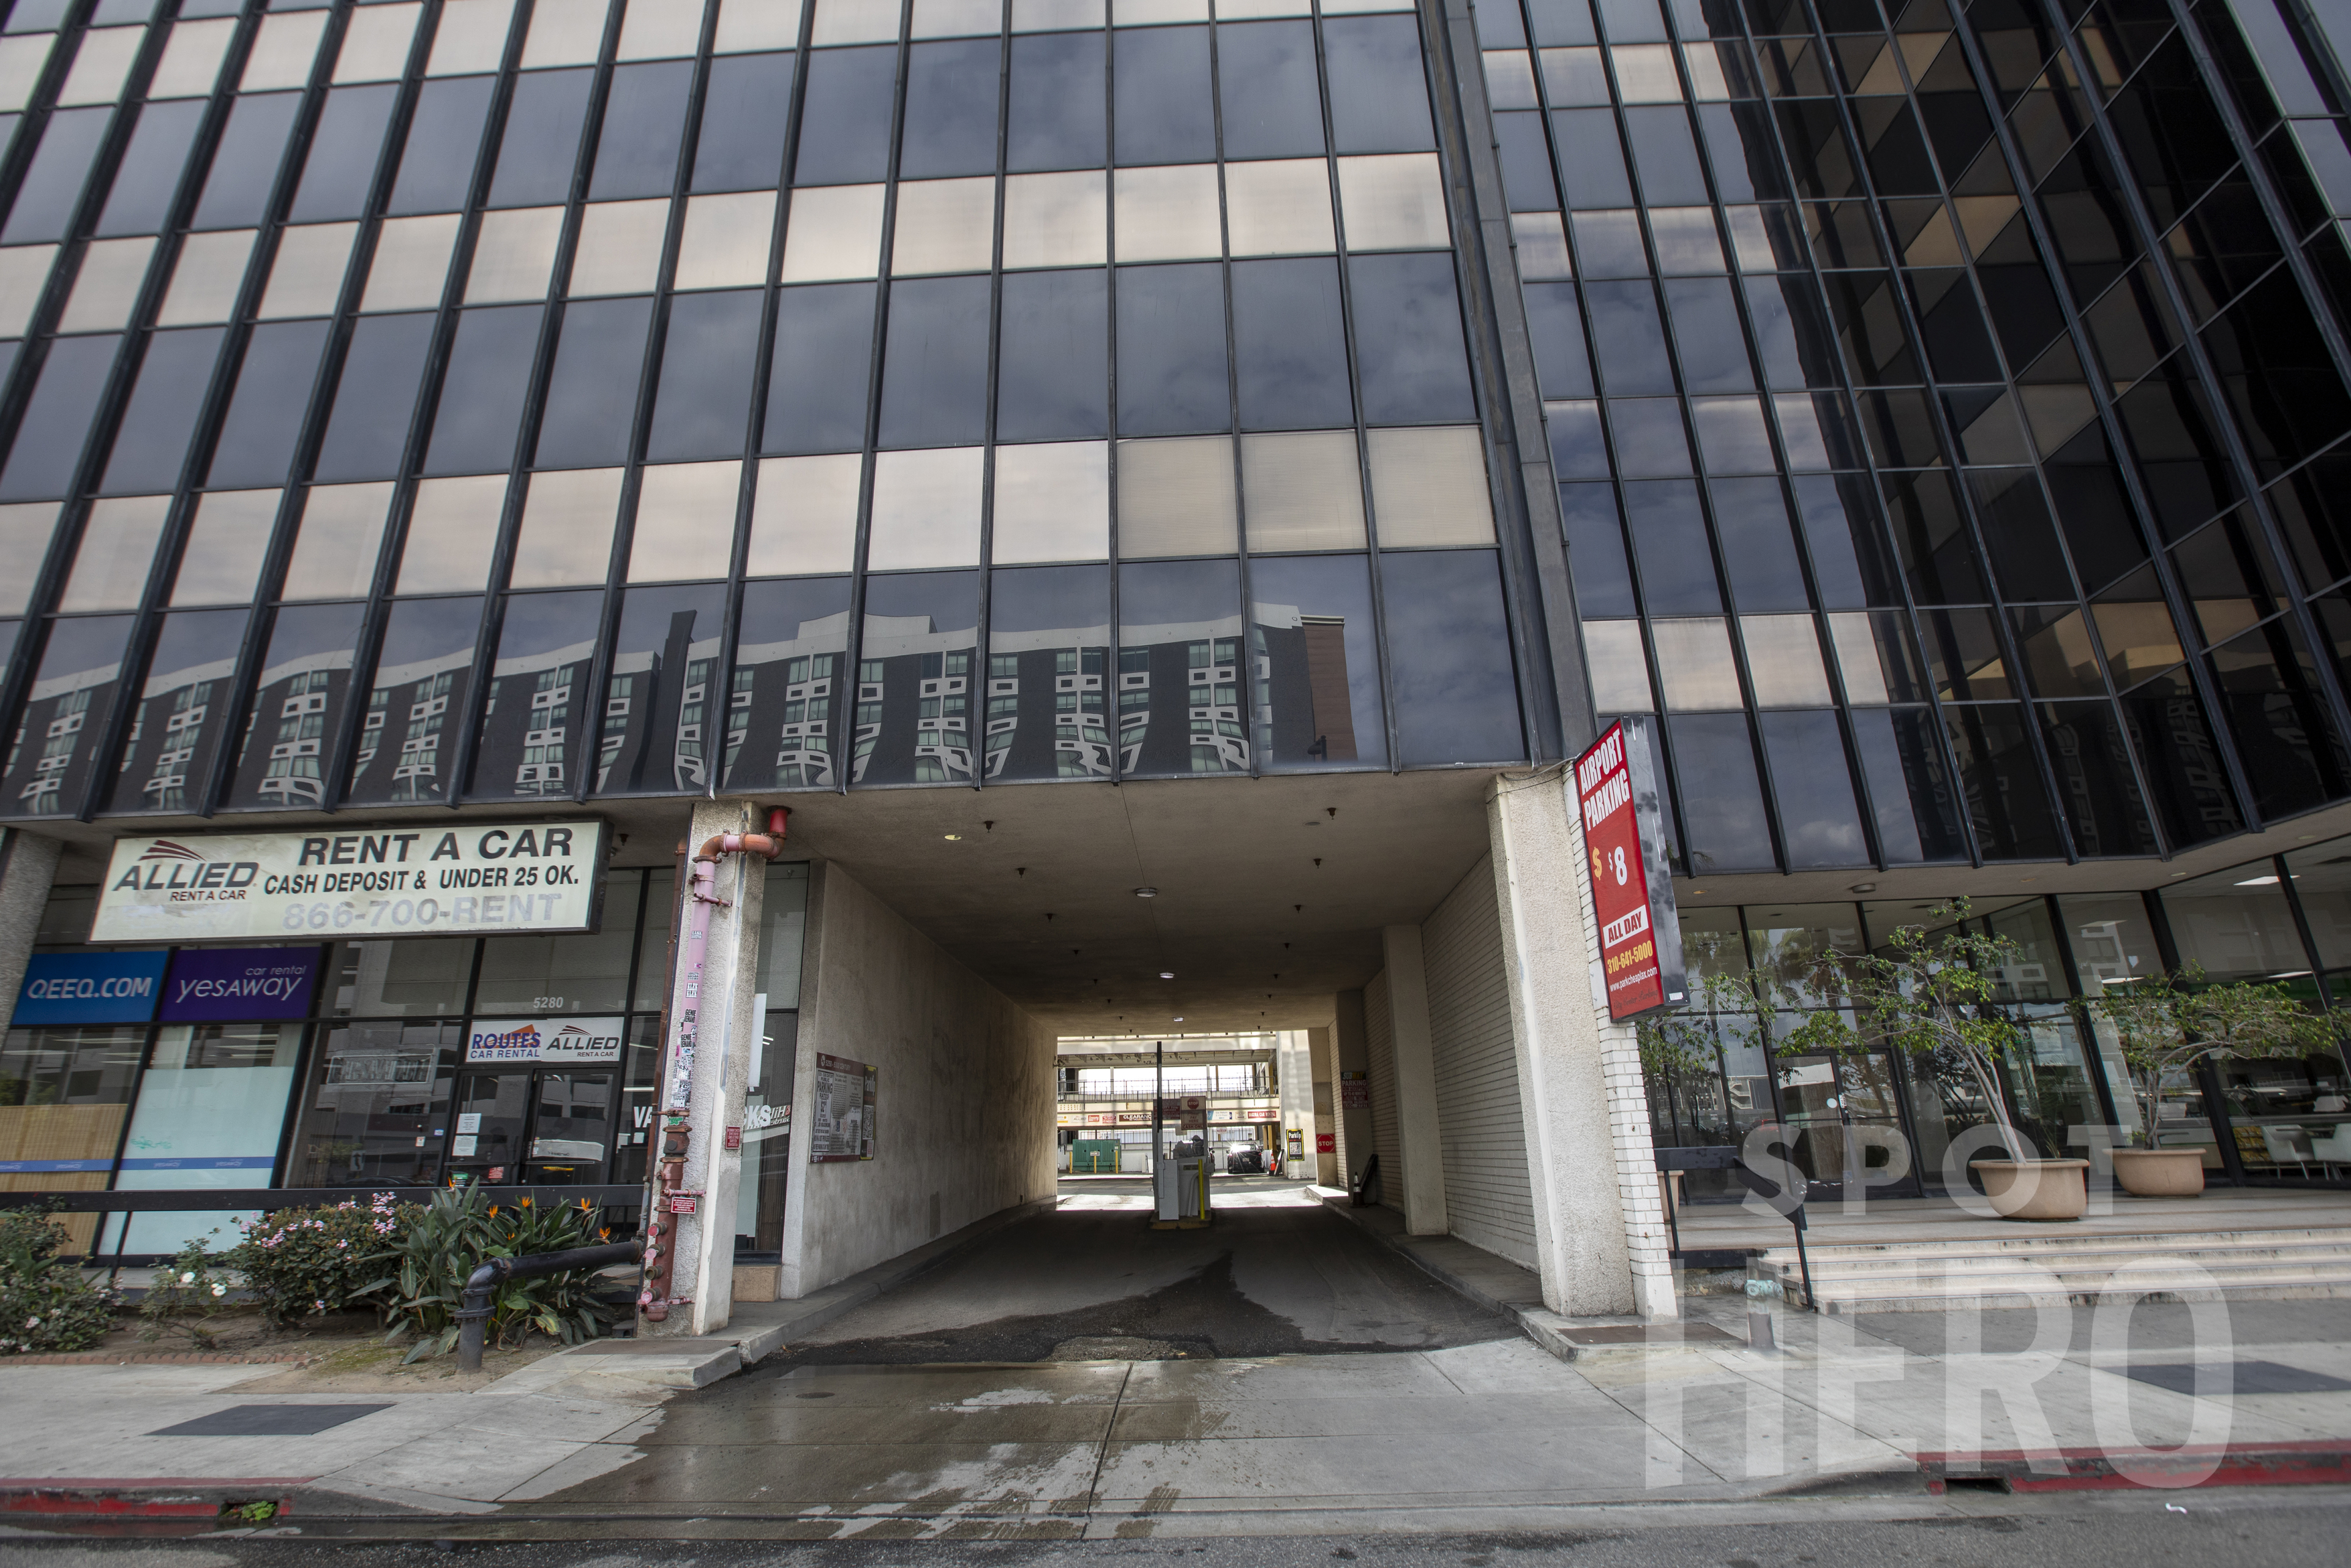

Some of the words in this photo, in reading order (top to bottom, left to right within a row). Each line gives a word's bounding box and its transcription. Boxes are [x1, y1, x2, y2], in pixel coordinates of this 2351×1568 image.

[1579, 728, 1622, 796] AIRPORT
[1584, 768, 1630, 832] PARKING
[298, 833, 420, 866] RENT
[430, 832, 461, 861] A
[478, 828, 573, 859] CAR
[111, 862, 259, 891] ALLIED
[264, 872, 316, 895] CASH
[323, 870, 408, 893] DEPOSIT
[413, 870, 427, 890] &
[440, 867, 508, 888] UNDER
[514, 866, 538, 886] 25
[544, 865, 579, 885] OK.
[170, 891, 204, 901] RENT
[205, 891, 215, 901] A
[219, 890, 246, 900] CAR
[282, 893, 562, 930] 866-700-RENT
[1608, 923, 1623, 943] ALL
[1624, 911, 1642, 937] DAY
[1607, 940, 1653, 974] 310-641-5000
[246, 967, 266, 976] car
[269, 965, 307, 975] rental
[1610, 966, 1657, 992] www.parkcheaplax.com
[28, 977, 152, 999] QEEQ.COM
[1623, 996, 1637, 1006] Center
[1638, 988, 1658, 1002] Parking
[533, 997, 563, 1009] 5280
[471, 1032, 541, 1049] ROUTES
[546, 1037, 620, 1050] ALLIED
[470, 1050, 493, 1059] CAR
[497, 1049, 540, 1058] RENTAL
[817, 1081, 833, 1094] PARKING
